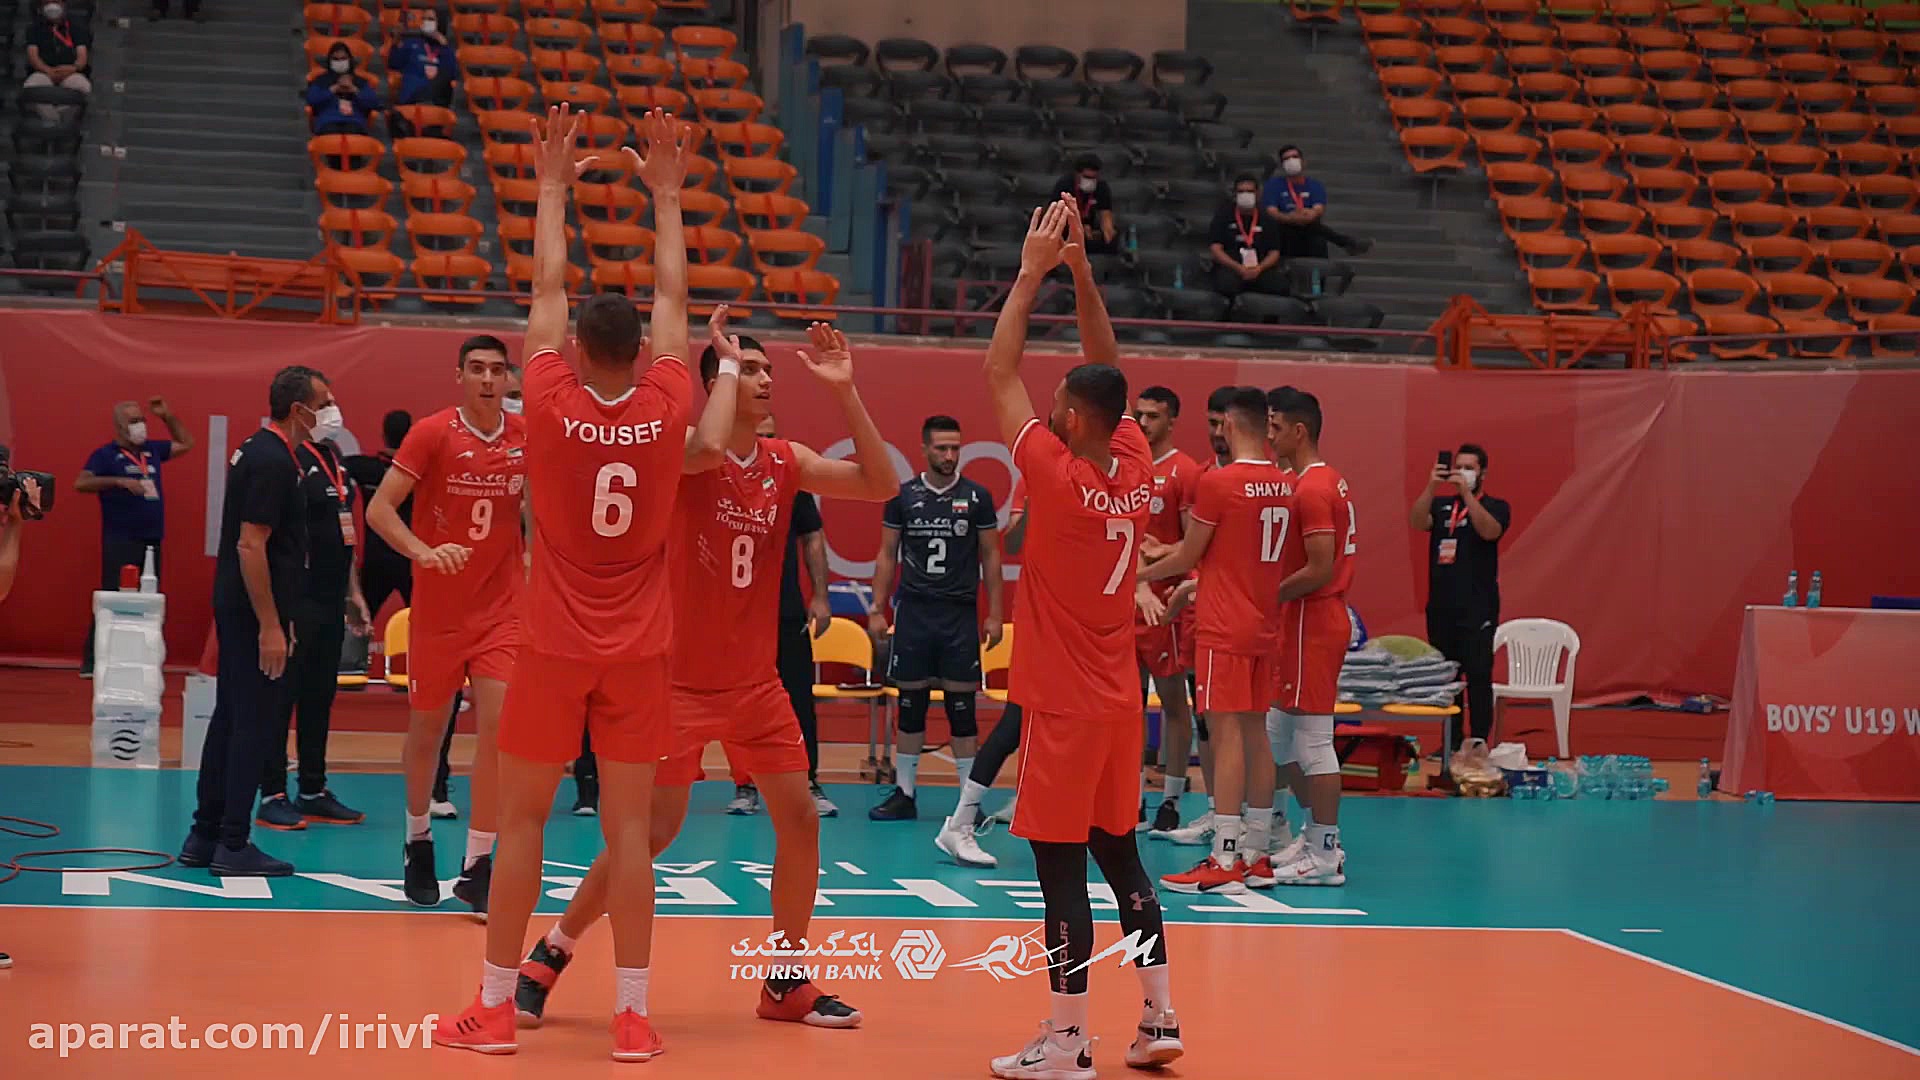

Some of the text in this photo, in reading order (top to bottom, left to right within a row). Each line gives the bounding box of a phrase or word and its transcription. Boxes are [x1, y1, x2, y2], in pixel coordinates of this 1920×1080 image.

[563, 417, 662, 445] YOUSEF
[592, 462, 637, 537] 6
[1244, 482, 1293, 498] SHAYA
[468, 498, 493, 541] 9
[1260, 506, 1290, 562] 17
[731, 535, 755, 588] 8
[926, 538, 947, 574] 2
[1103, 518, 1134, 595] 7
[1766, 703, 1836, 733] BOYS'
[1845, 706, 1896, 735] U19
